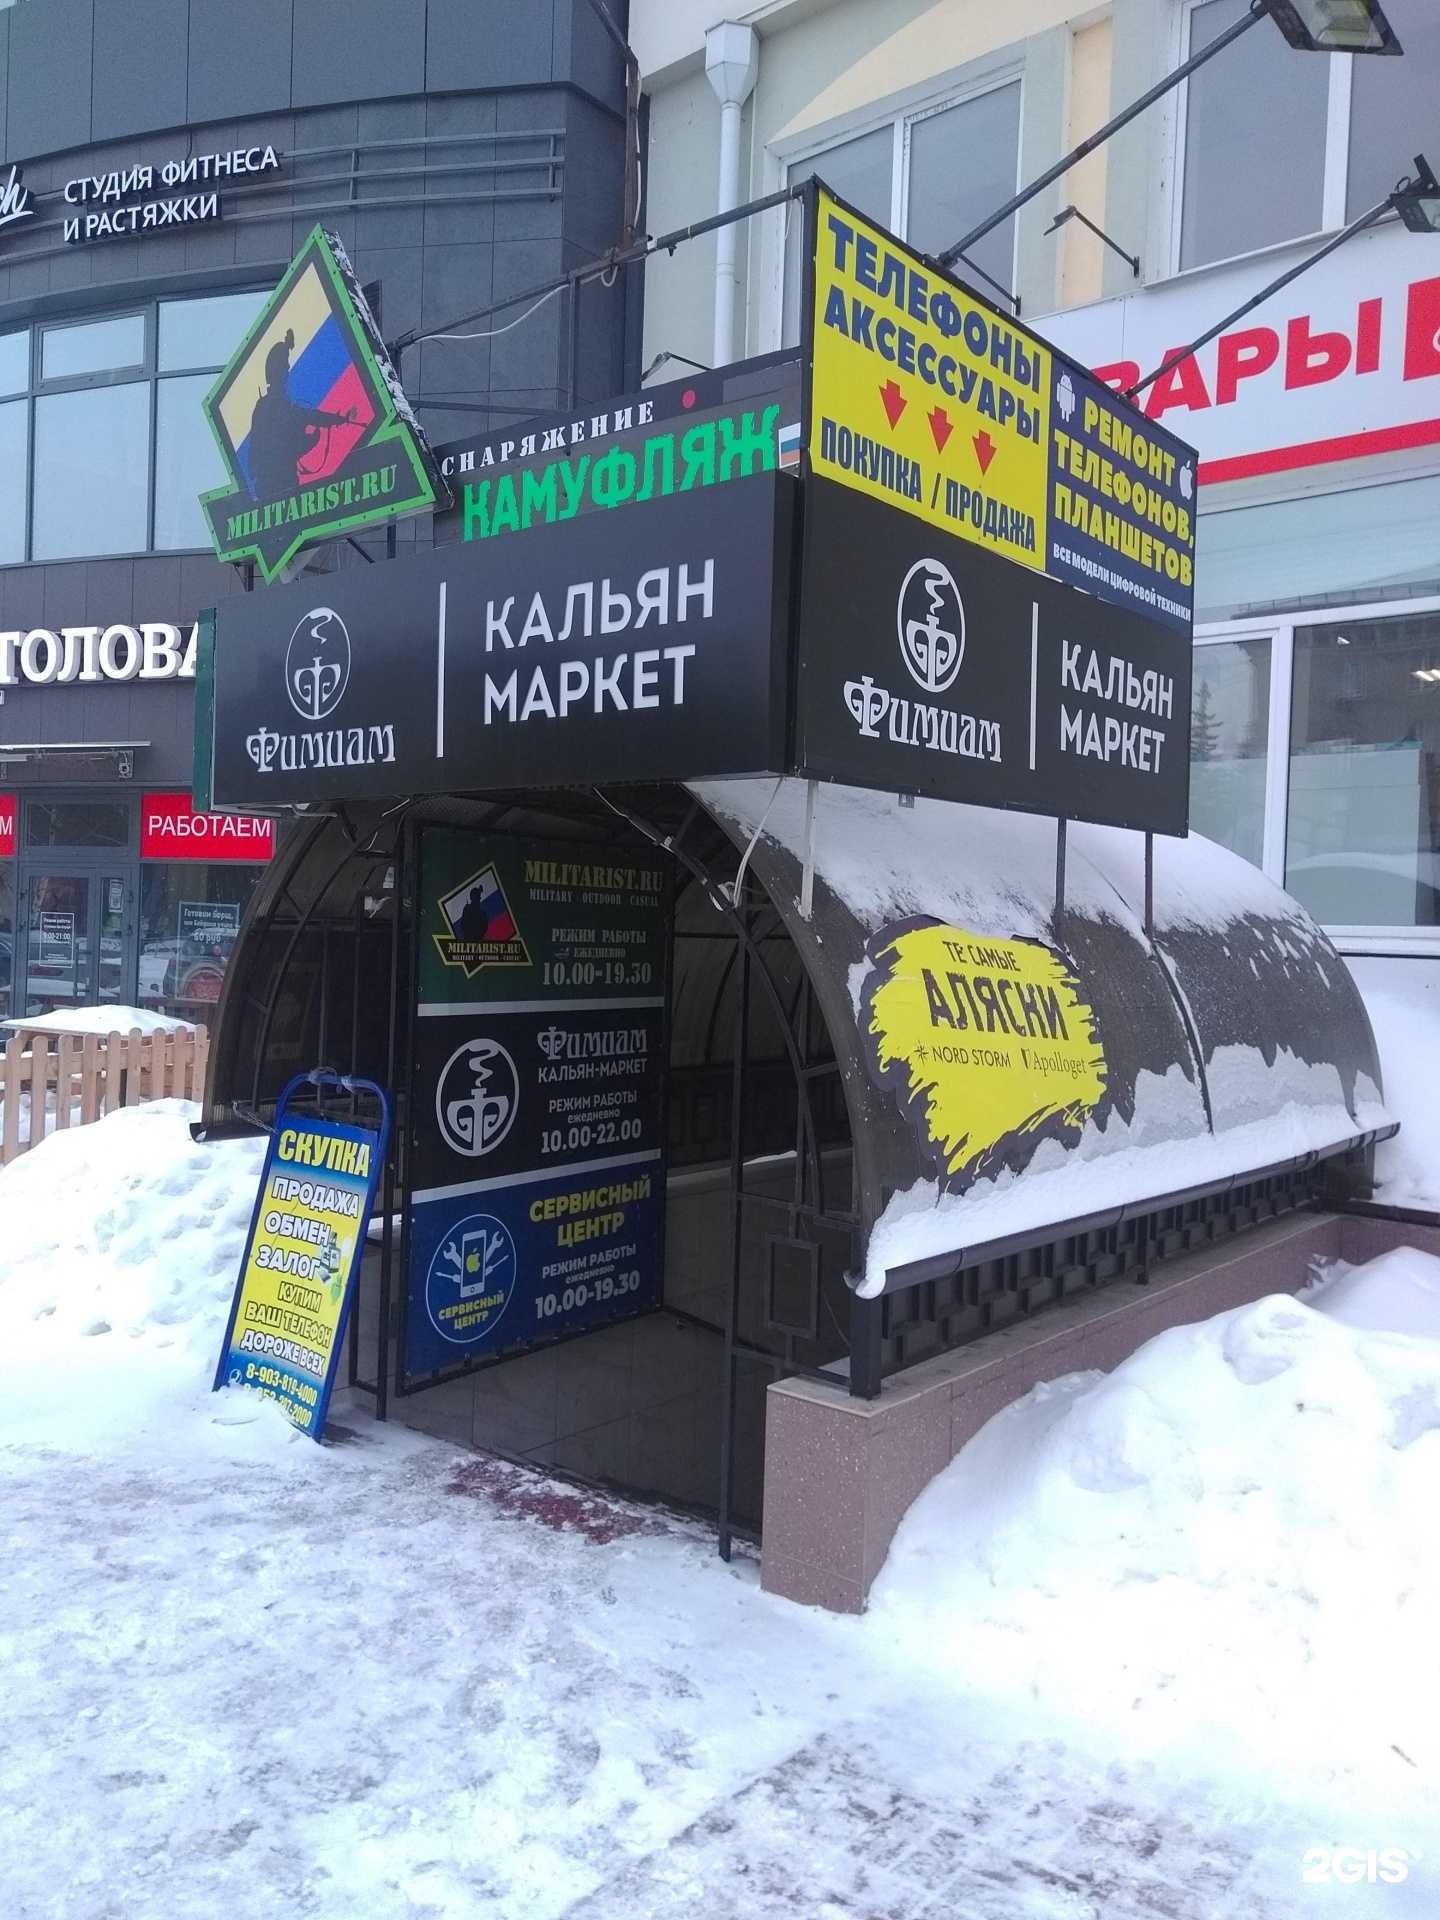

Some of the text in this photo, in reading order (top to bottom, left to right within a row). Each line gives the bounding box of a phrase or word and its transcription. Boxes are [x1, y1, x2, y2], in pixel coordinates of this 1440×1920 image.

[64, 145, 279, 204] СТУДИЯ ФИТНЕСА
[63, 194, 218, 242] И РАСТЯЖКИ
[828, 214, 1040, 395] ТЕЛЕФОНЫ
[824, 284, 1040, 444] АКСЕССУАРЫ
[441, 401, 654, 476] СНАРЯЖЕНИЕ
[1084, 397, 1175, 487] РЕМОНТ
[463, 404, 781, 541] КАМУФЛЯЖ
[821, 416, 922, 502] ПОКУПКА
[945, 479, 1036, 553] ПРОДАЖА
[1054, 429, 1194, 548] ТЕЛЕФОНОВ,
[226, 464, 397, 541] MILITARIST.RU
[1055, 482, 1192, 587] ПЛАНШЕТОВ
[484, 558, 716, 652] КАЛЬЯН
[1053, 543, 1191, 622] ВСЕ МОДЕЛИ ЦИФРОВОЙ ТЕХНИКИ
[483, 644, 696, 725] МАРКЕТ
[1061, 639, 1174, 720] КАЛЬЯН
[843, 675, 1002, 763] Фимиам
[1060, 703, 1165, 774] МАРКЕТ
[246, 723, 396, 772] Фимиам
[148, 815, 271, 837] РАБОТАЕМ
[524, 860, 664, 892] MILITARIST.RU
[552, 928, 647, 944] РЕЖИМ РАБОТЫ
[942, 940, 1021, 972] ТЕ САМЫЕ
[542, 962, 651, 985] 10.00-19.30
[921, 968, 1069, 1041] АЛЯСКИ
[538, 1058, 647, 1083] КАЛЬЯН-МАРКЕТ
[932, 1046, 1087, 1079] NORD STORM Apolloget
[549, 1090, 637, 1113] РЕЖИМ РАБОТЫ
[568, 1108, 620, 1123] ежедневно
[278, 1129, 370, 1177] СКУПКА
[541, 1119, 642, 1153] 10.00-22.00
[272, 1176, 360, 1218] ПРОДАЖА
[529, 1175, 651, 1222] СЕРВИСНЫЙ
[265, 1211, 331, 1247] ОБМЕН
[557, 1212, 625, 1248] ЦЕНТР
[256, 1245, 321, 1281] ЗАЛОГ
[542, 1243, 637, 1279] РЕЖИМ РАБОТЫ
[278, 1282, 322, 1312] КУПИМ
[438, 1290, 505, 1320] СЕРВИСНЫЙ
[535, 1270, 641, 1319] 10.00-19.30
[245, 1302, 333, 1349] ВАШ ТЕЛЕФОН
[454, 1311, 488, 1330] ЦЕНТР
[240, 1329, 325, 1376] ДОРОЖЕ ВСЕХ
